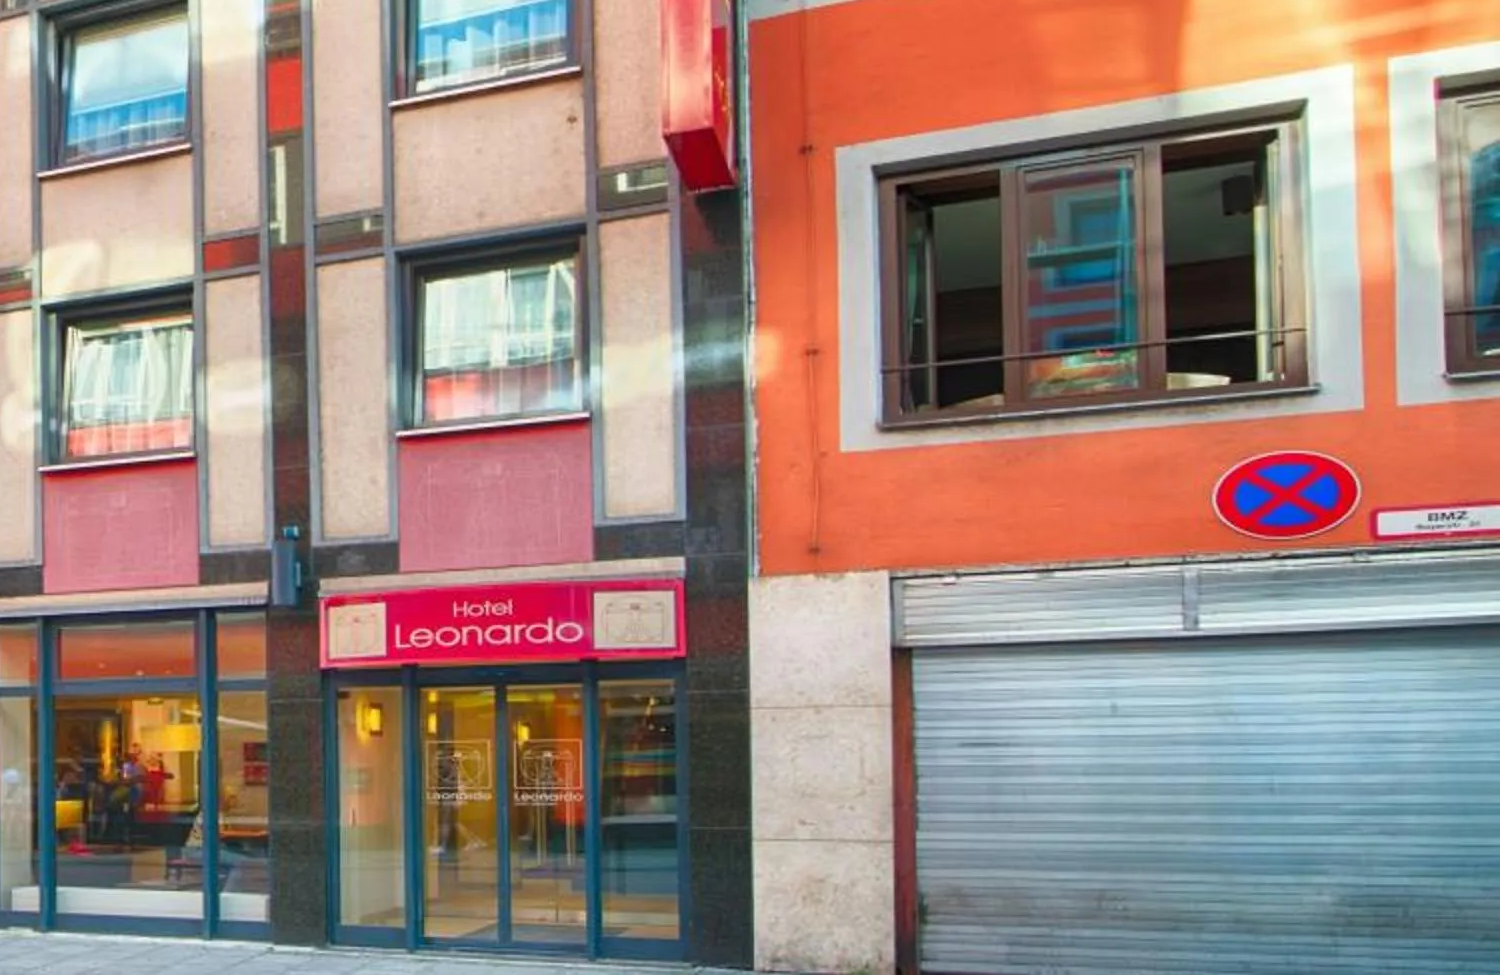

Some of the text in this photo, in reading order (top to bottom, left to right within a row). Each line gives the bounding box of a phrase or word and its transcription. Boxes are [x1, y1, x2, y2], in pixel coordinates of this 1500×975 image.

[452, 600, 514, 618] Hotel
[395, 618, 584, 649] Leonardo
[514, 791, 584, 802] Leonardo
